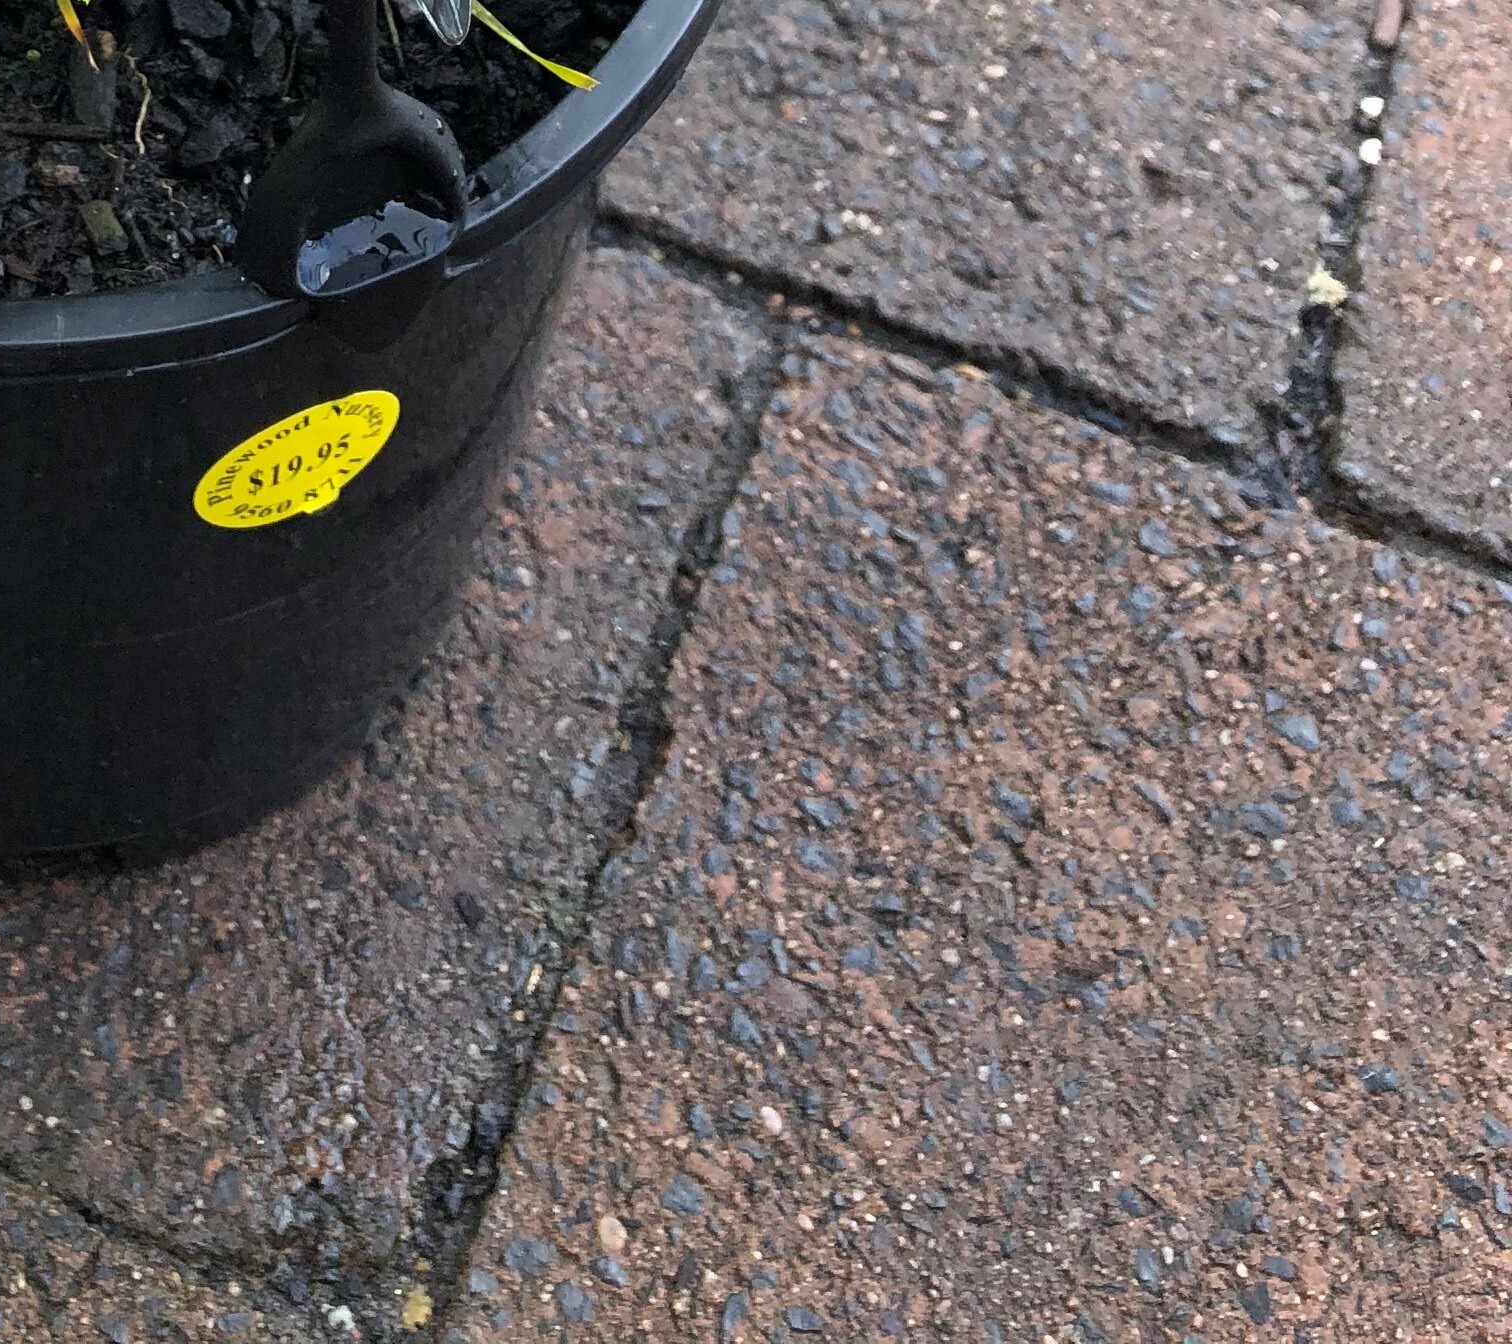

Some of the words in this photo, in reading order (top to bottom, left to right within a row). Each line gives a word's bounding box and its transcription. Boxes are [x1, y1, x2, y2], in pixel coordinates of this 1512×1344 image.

[207, 415, 310, 507] Pinewood
[323, 401, 384, 439] Nursery
[248, 433, 351, 496] $19.95
[304, 457, 364, 503] 8711
